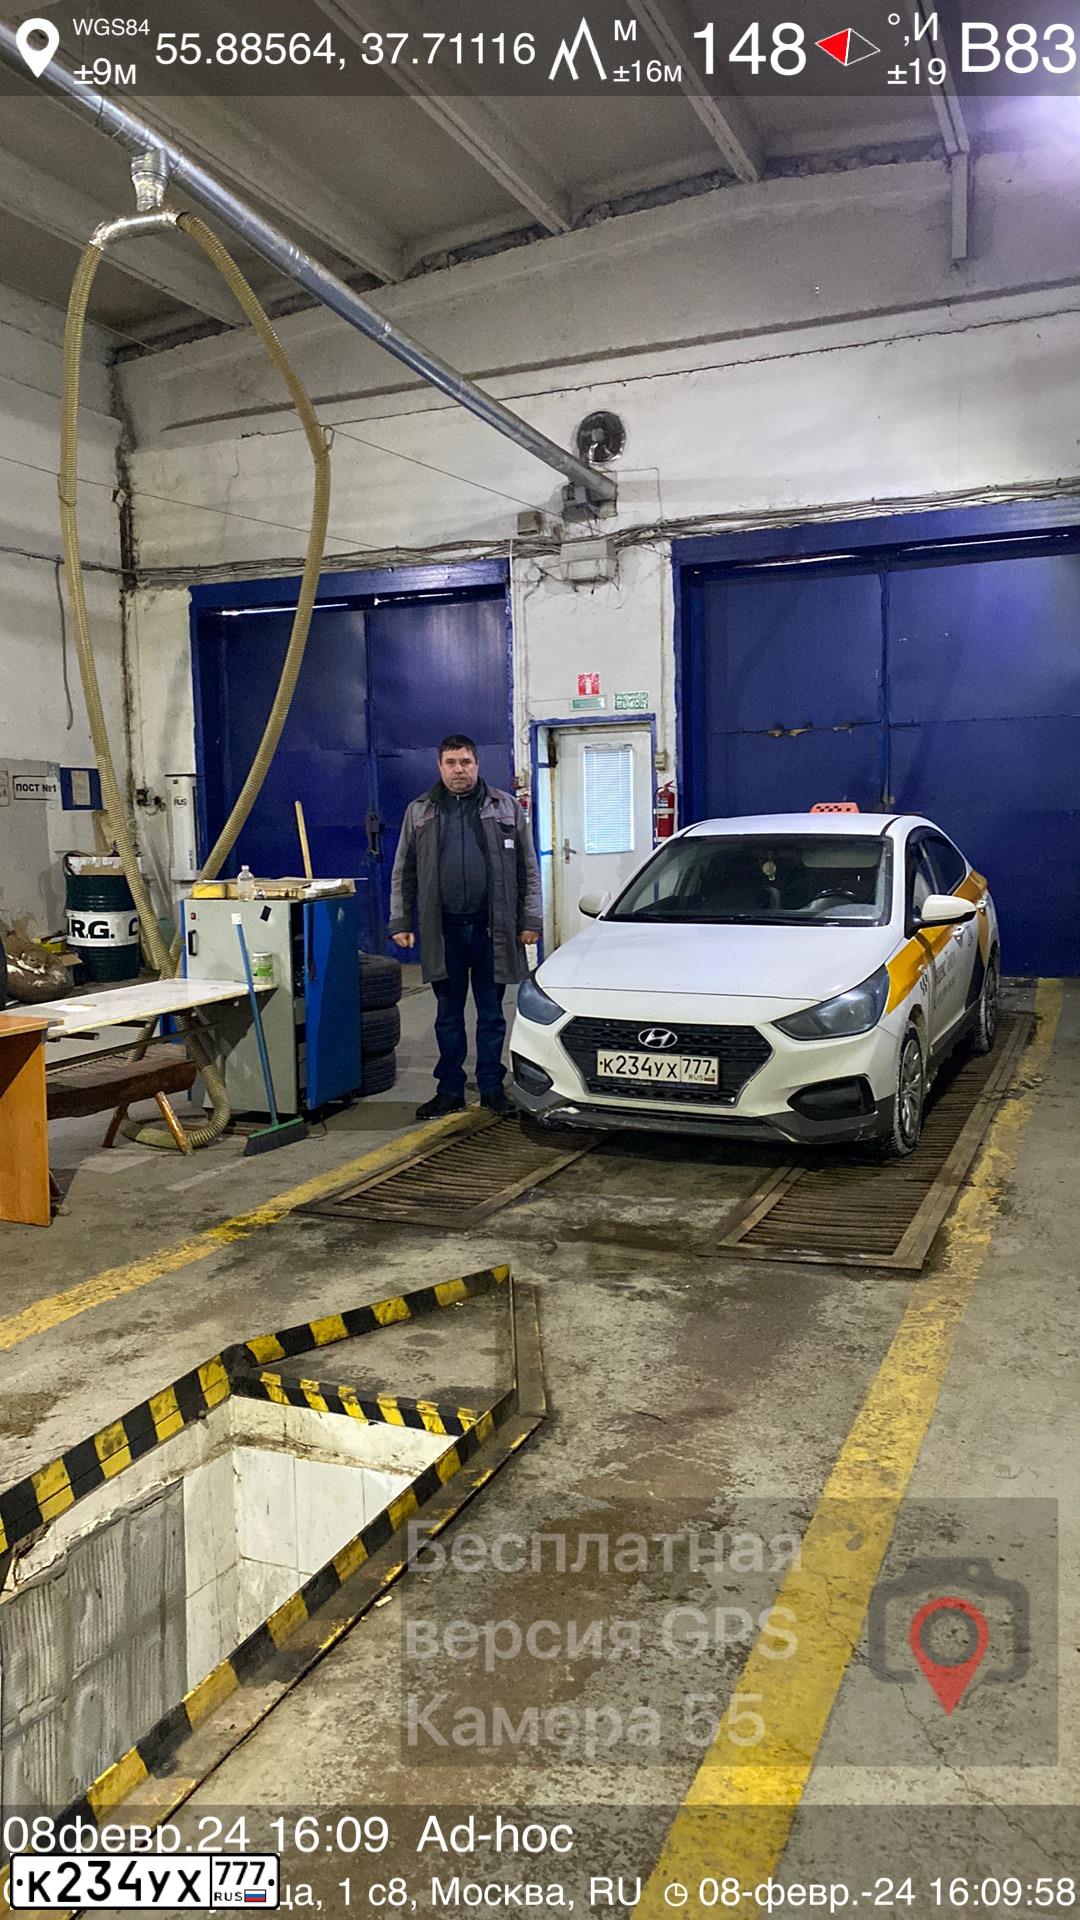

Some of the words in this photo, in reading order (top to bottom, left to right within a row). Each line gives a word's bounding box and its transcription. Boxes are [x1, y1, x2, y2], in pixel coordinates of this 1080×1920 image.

[16, 783, 40, 792] ПОСТ
[42, 784, 57, 792] №1
[682, 1058, 712, 1075] 777
